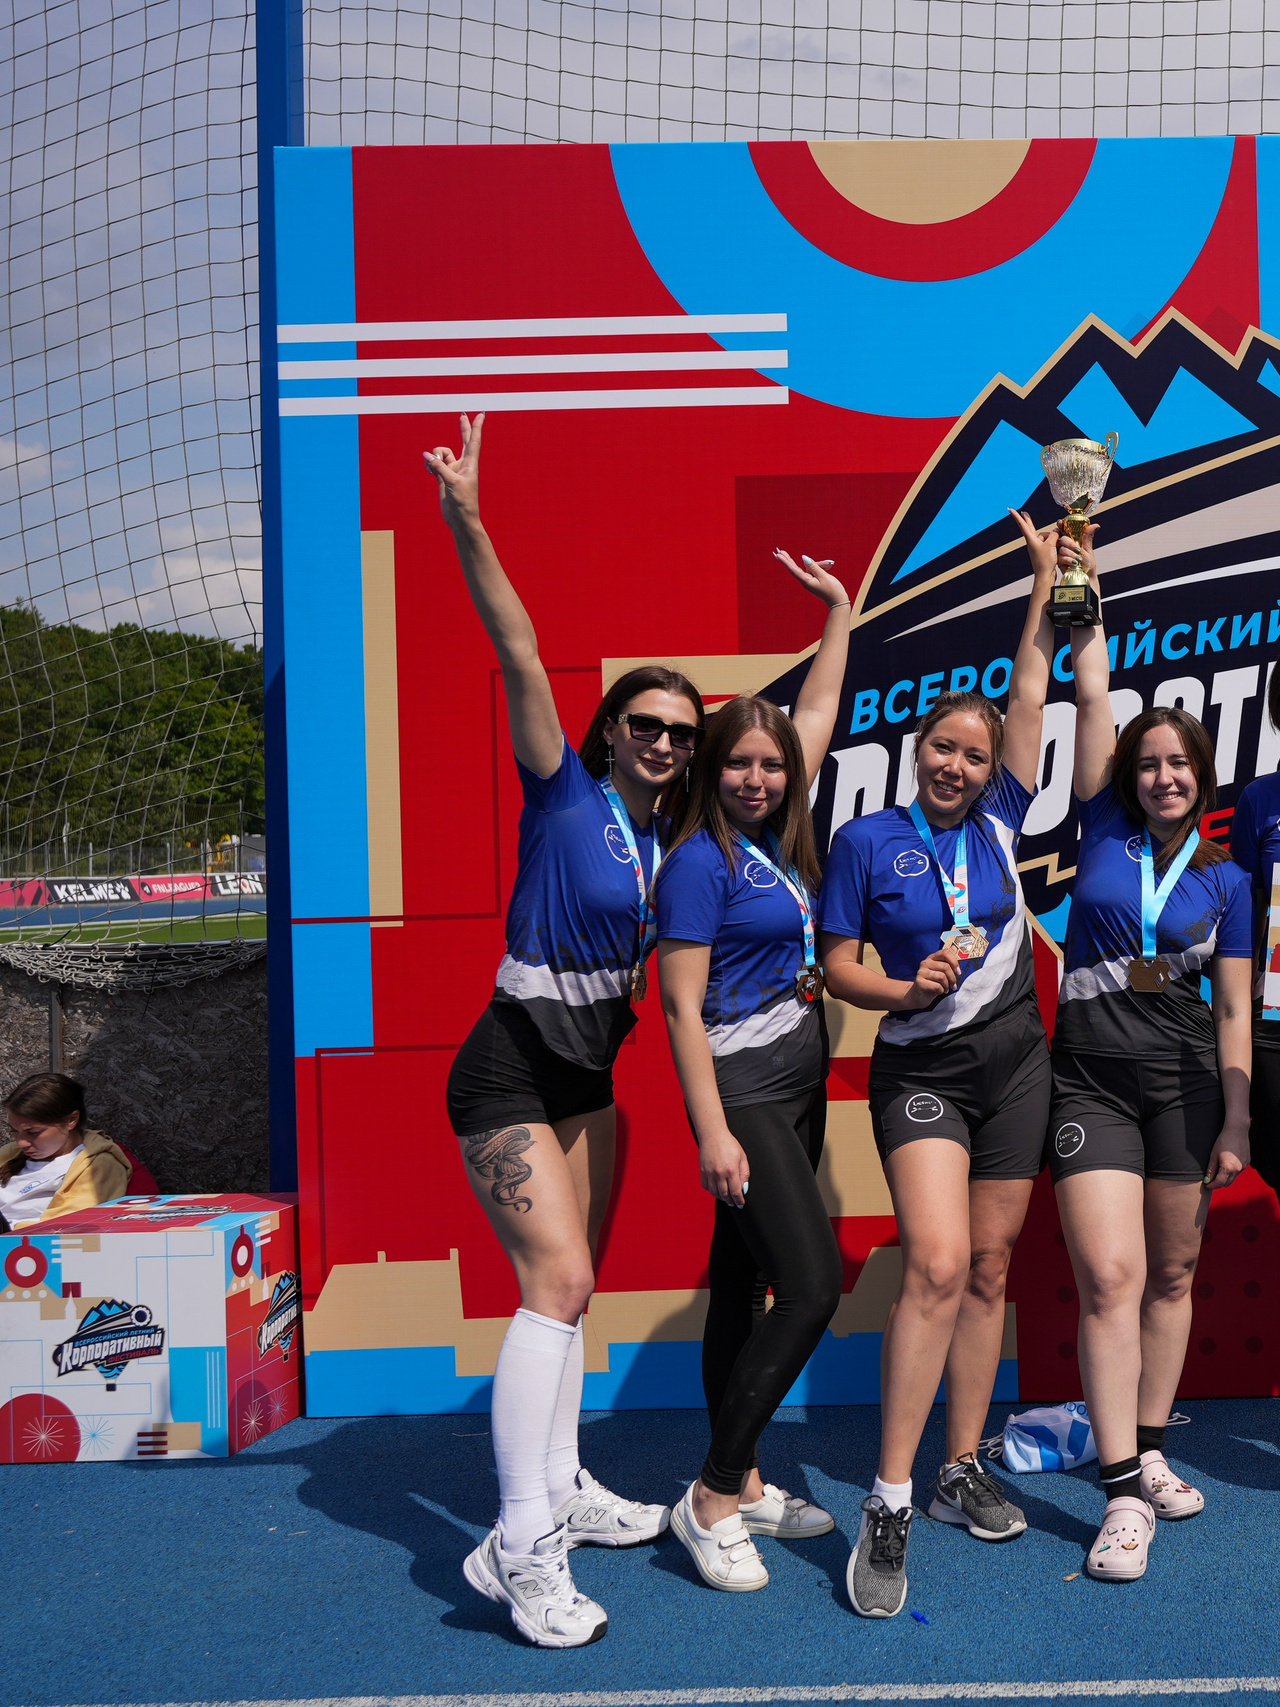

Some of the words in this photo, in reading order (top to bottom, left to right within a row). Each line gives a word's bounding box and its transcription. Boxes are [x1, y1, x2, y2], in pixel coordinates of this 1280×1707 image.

[54, 882, 121, 902] KELME
[74, 1331, 129, 1348] ВСЕРОССИЙСКИЙ
[129, 1328, 155, 1337] ЛЕТНИЙ
[60, 1330, 163, 1374] Корпоративный
[107, 1349, 160, 1363] ФЕСТИВАЛЬ
